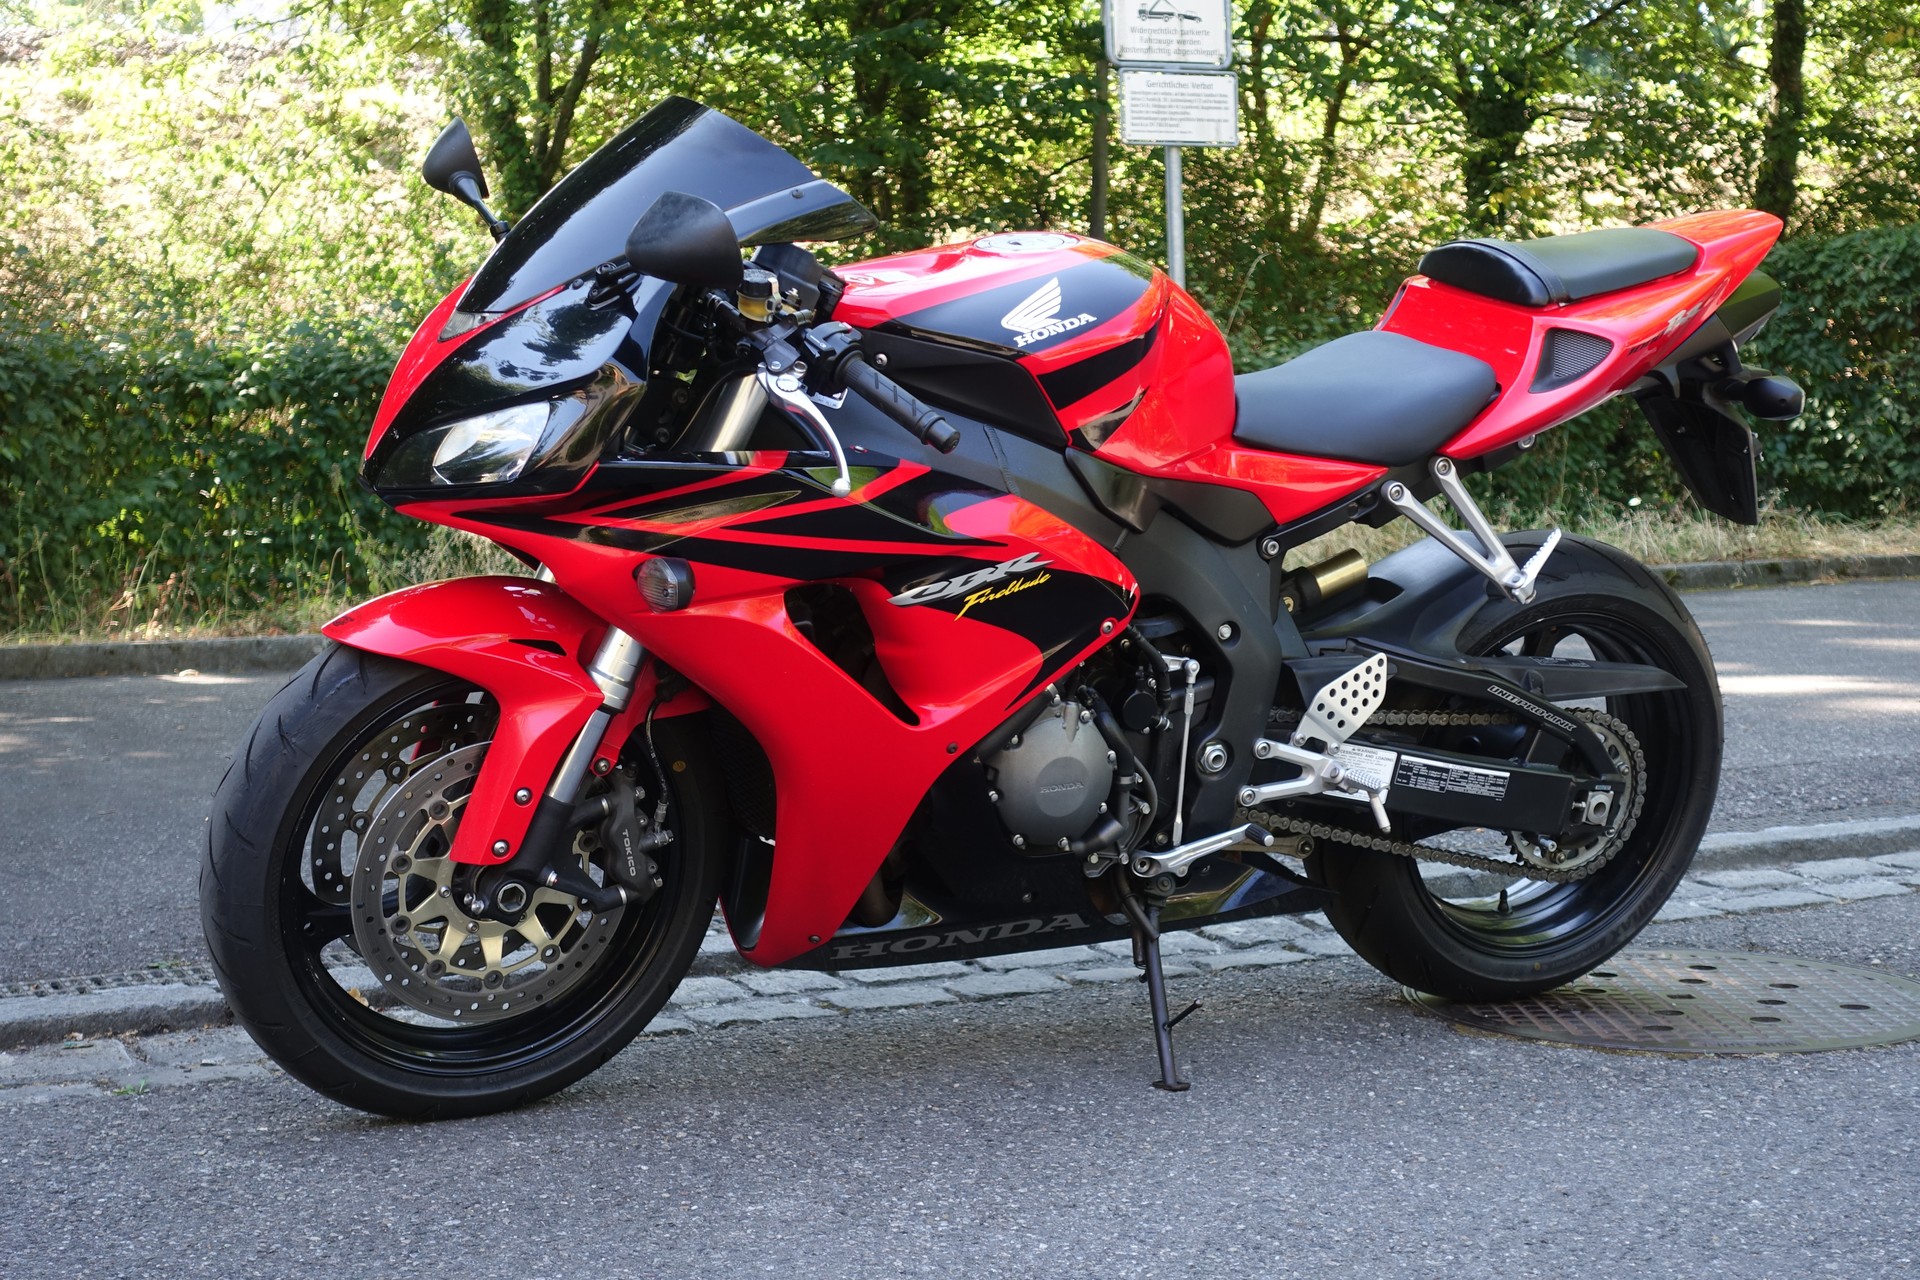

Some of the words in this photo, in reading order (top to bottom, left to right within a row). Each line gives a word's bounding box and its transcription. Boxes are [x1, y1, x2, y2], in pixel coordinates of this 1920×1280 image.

[1140, 36, 1174, 46] Fahrzeuge
[1176, 38, 1201, 46] werden
[1147, 80, 1189, 90] Gerichtliches
[1192, 82, 1213, 90] Verbot
[1013, 313, 1098, 348] HONDA
[886, 551, 1055, 606] CBR
[954, 570, 1052, 622] Fireblade
[1487, 684, 1520, 705] UNIT
[1040, 782, 1084, 793] HONDA
[622, 828, 637, 877] TOKICO
[829, 913, 1091, 960] HONDA
